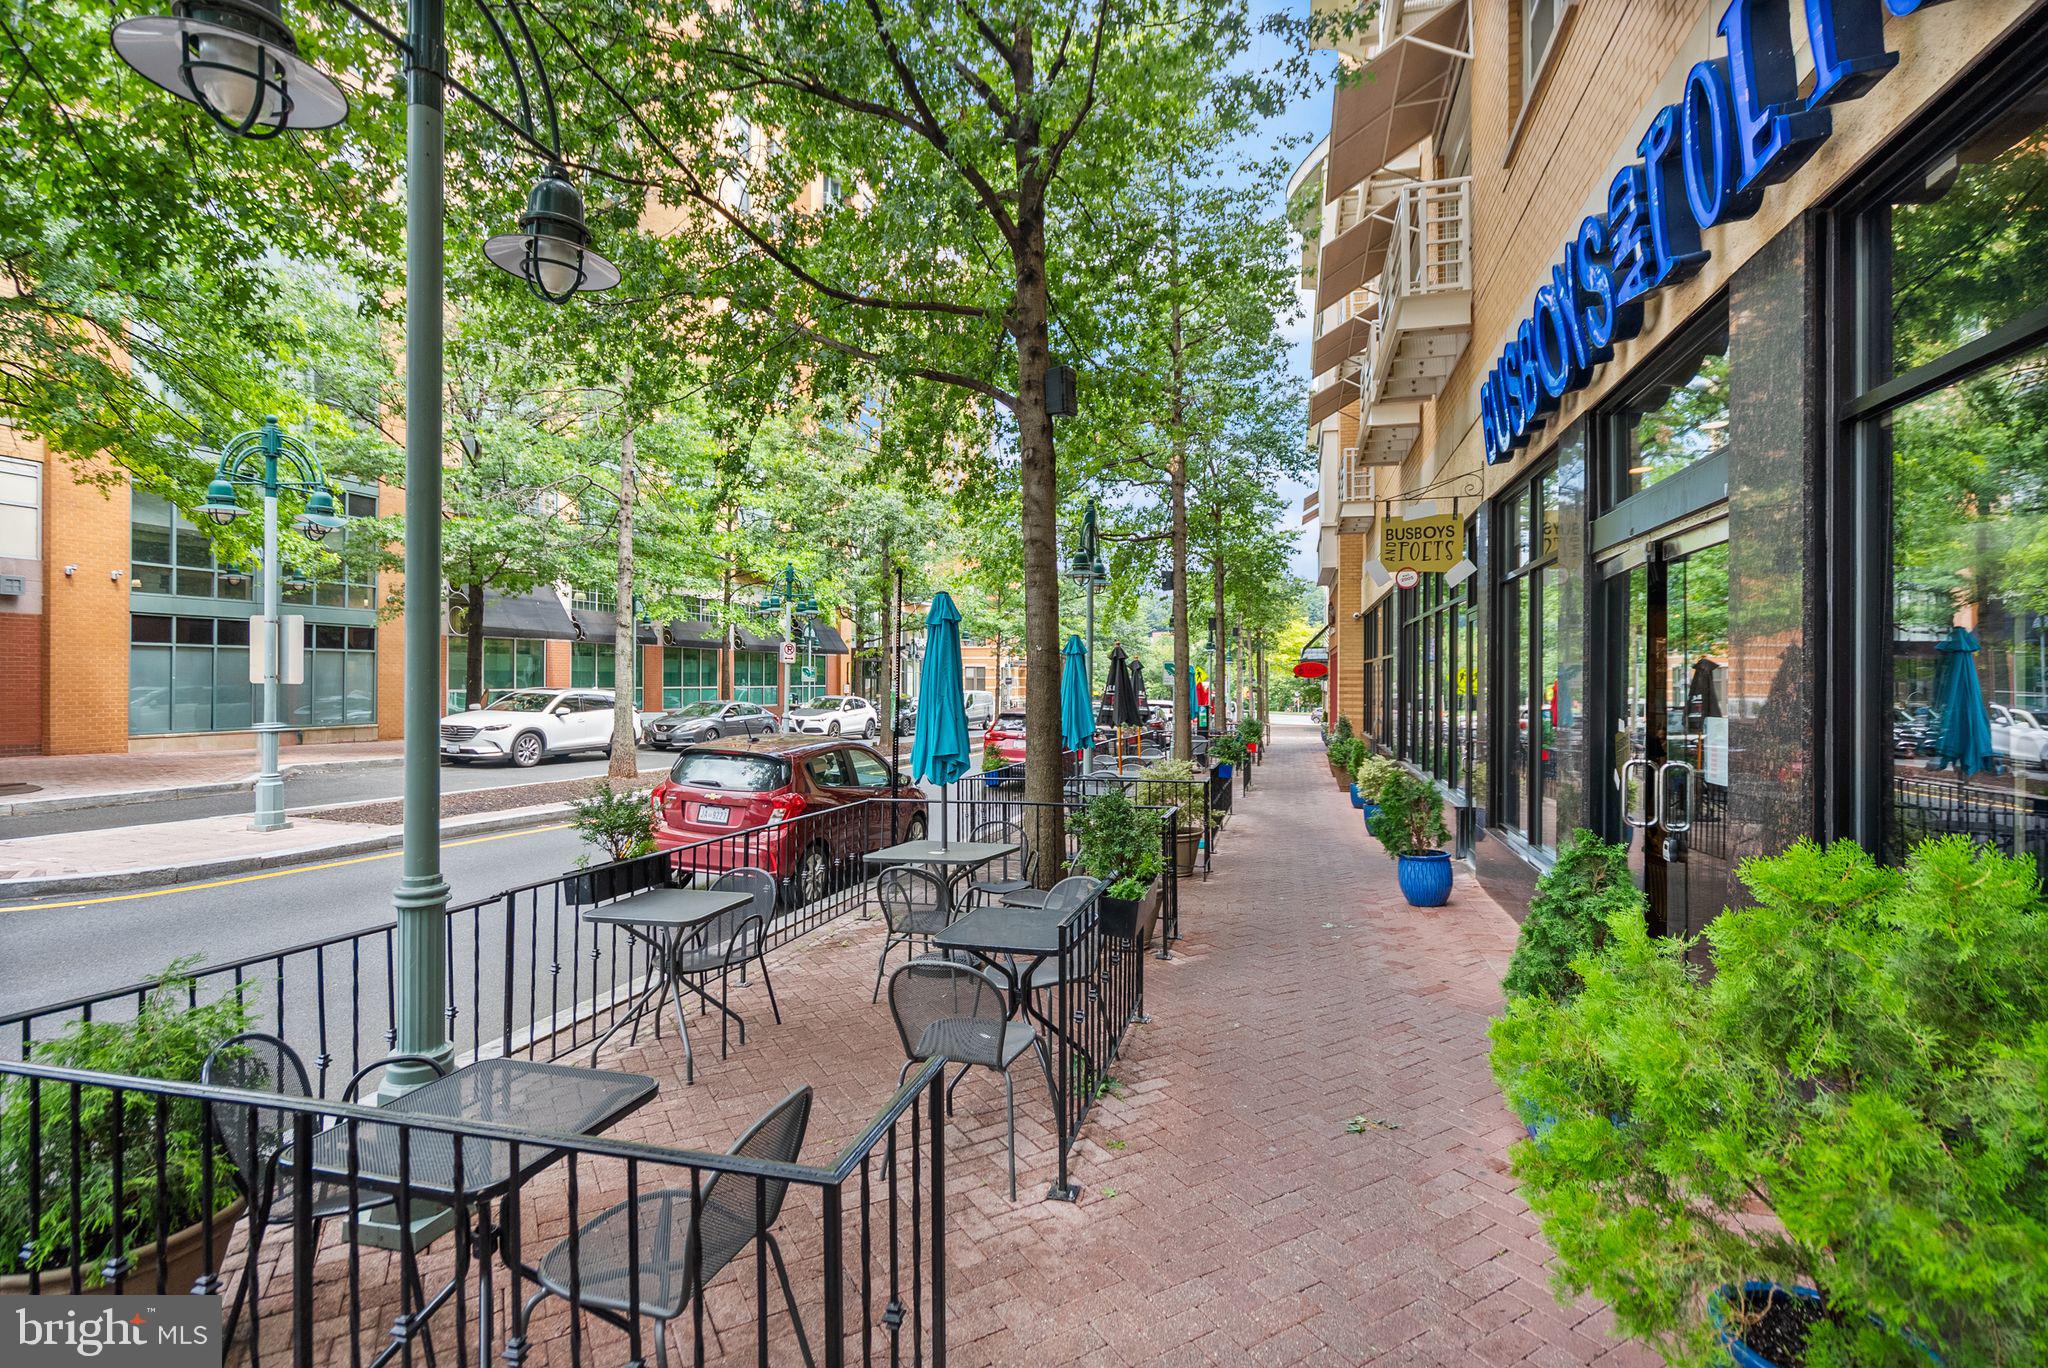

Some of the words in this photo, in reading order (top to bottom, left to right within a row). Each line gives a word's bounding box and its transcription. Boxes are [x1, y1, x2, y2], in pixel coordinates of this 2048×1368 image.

[1480, 215, 1617, 466] BUSBOYS
[1385, 524, 1455, 541] BUSBOYS
[1384, 541, 1397, 562] AND
[1398, 540, 1454, 562] POETS
